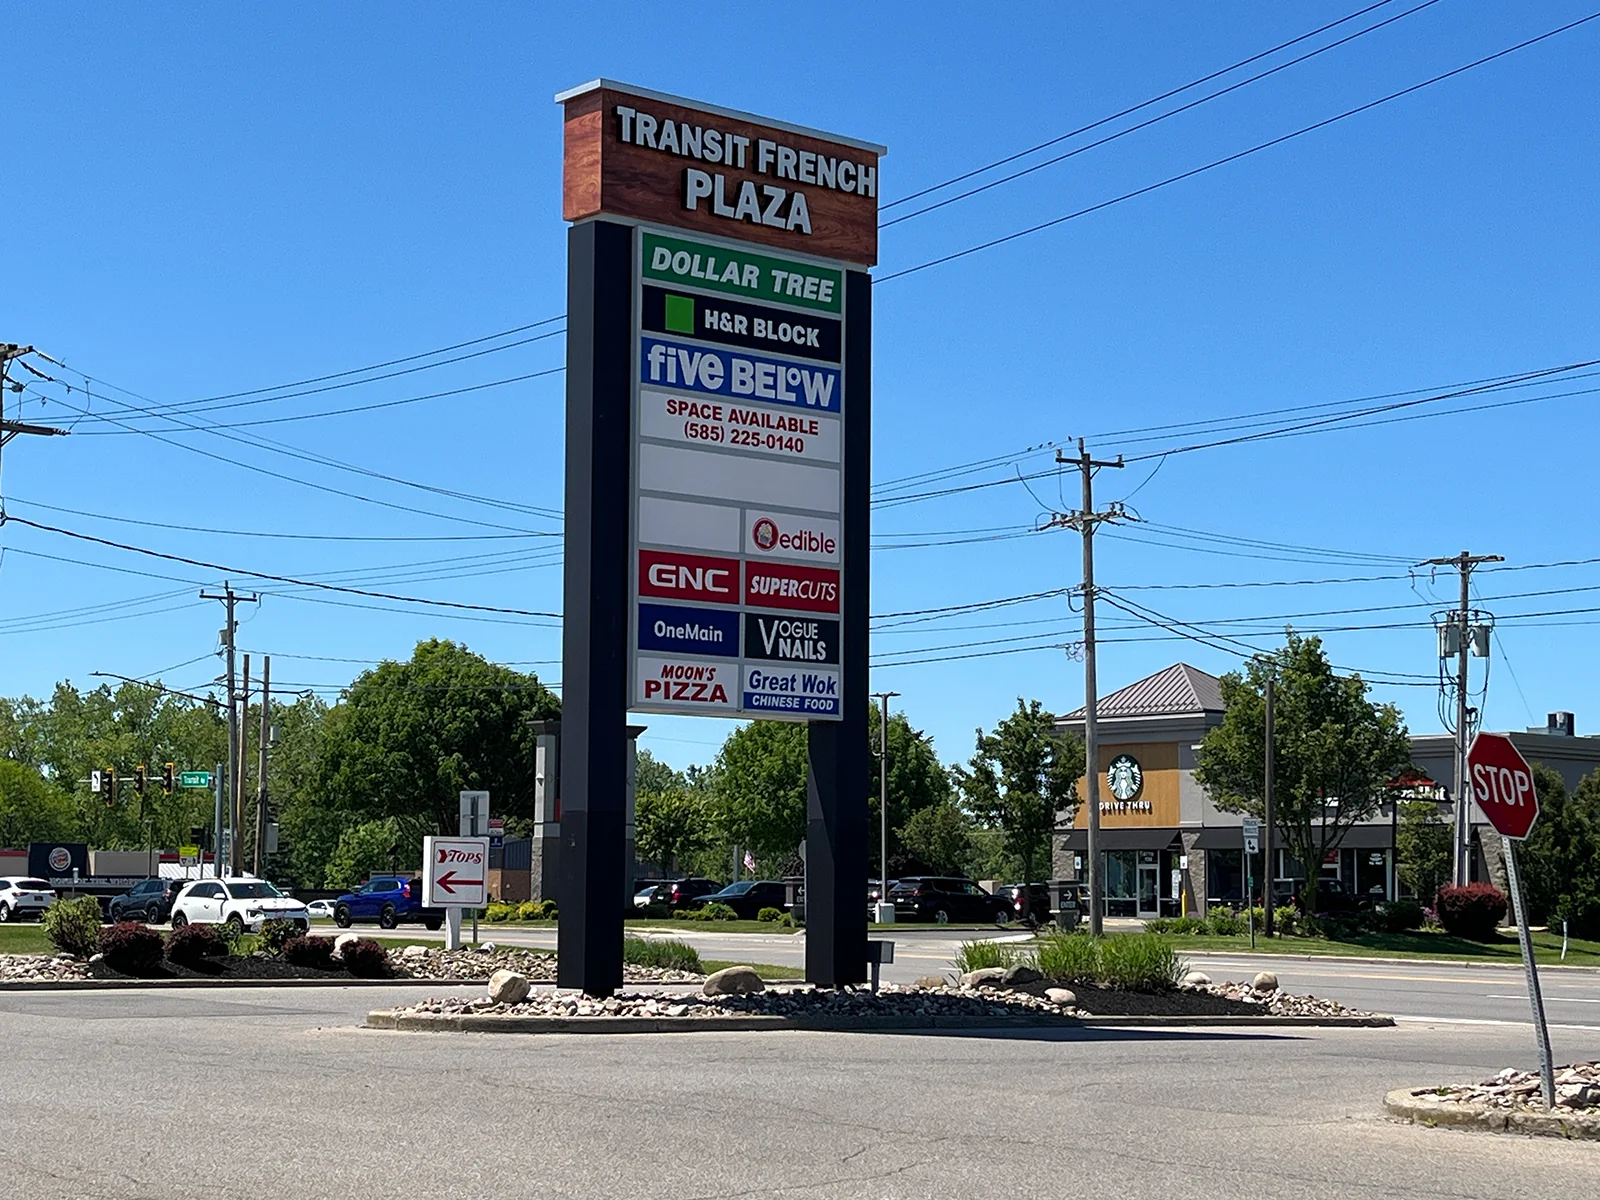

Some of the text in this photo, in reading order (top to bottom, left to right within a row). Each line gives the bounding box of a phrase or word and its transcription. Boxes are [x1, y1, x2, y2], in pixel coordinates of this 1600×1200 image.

[616, 105, 876, 198] TRANSIT FRENCH
[685, 167, 813, 235] PLAZA
[651, 247, 835, 303] DOLLAR TREE
[704, 309, 820, 348] H&R BLOCK
[647, 344, 835, 408] five BELOW
[666, 398, 819, 436] SPACE AVAILABLE
[683, 420, 805, 453] (585) 225-0140
[779, 529, 836, 555] edible
[648, 563, 730, 593] GNC
[750, 575, 837, 602] SUPERCUTS
[653, 619, 723, 643] OneMain
[758, 618, 819, 655] VOGUE
[778, 637, 827, 661] NAILS
[660, 664, 717, 682] MOON'S
[749, 670, 837, 695] Great Wok
[644, 679, 728, 704] PIZZA
[751, 694, 834, 712] CHINESE FOOD
[1473, 763, 1530, 807] STOP
[1098, 800, 1151, 811] DRIVE THRU
[447, 849, 483, 865] TOPS
